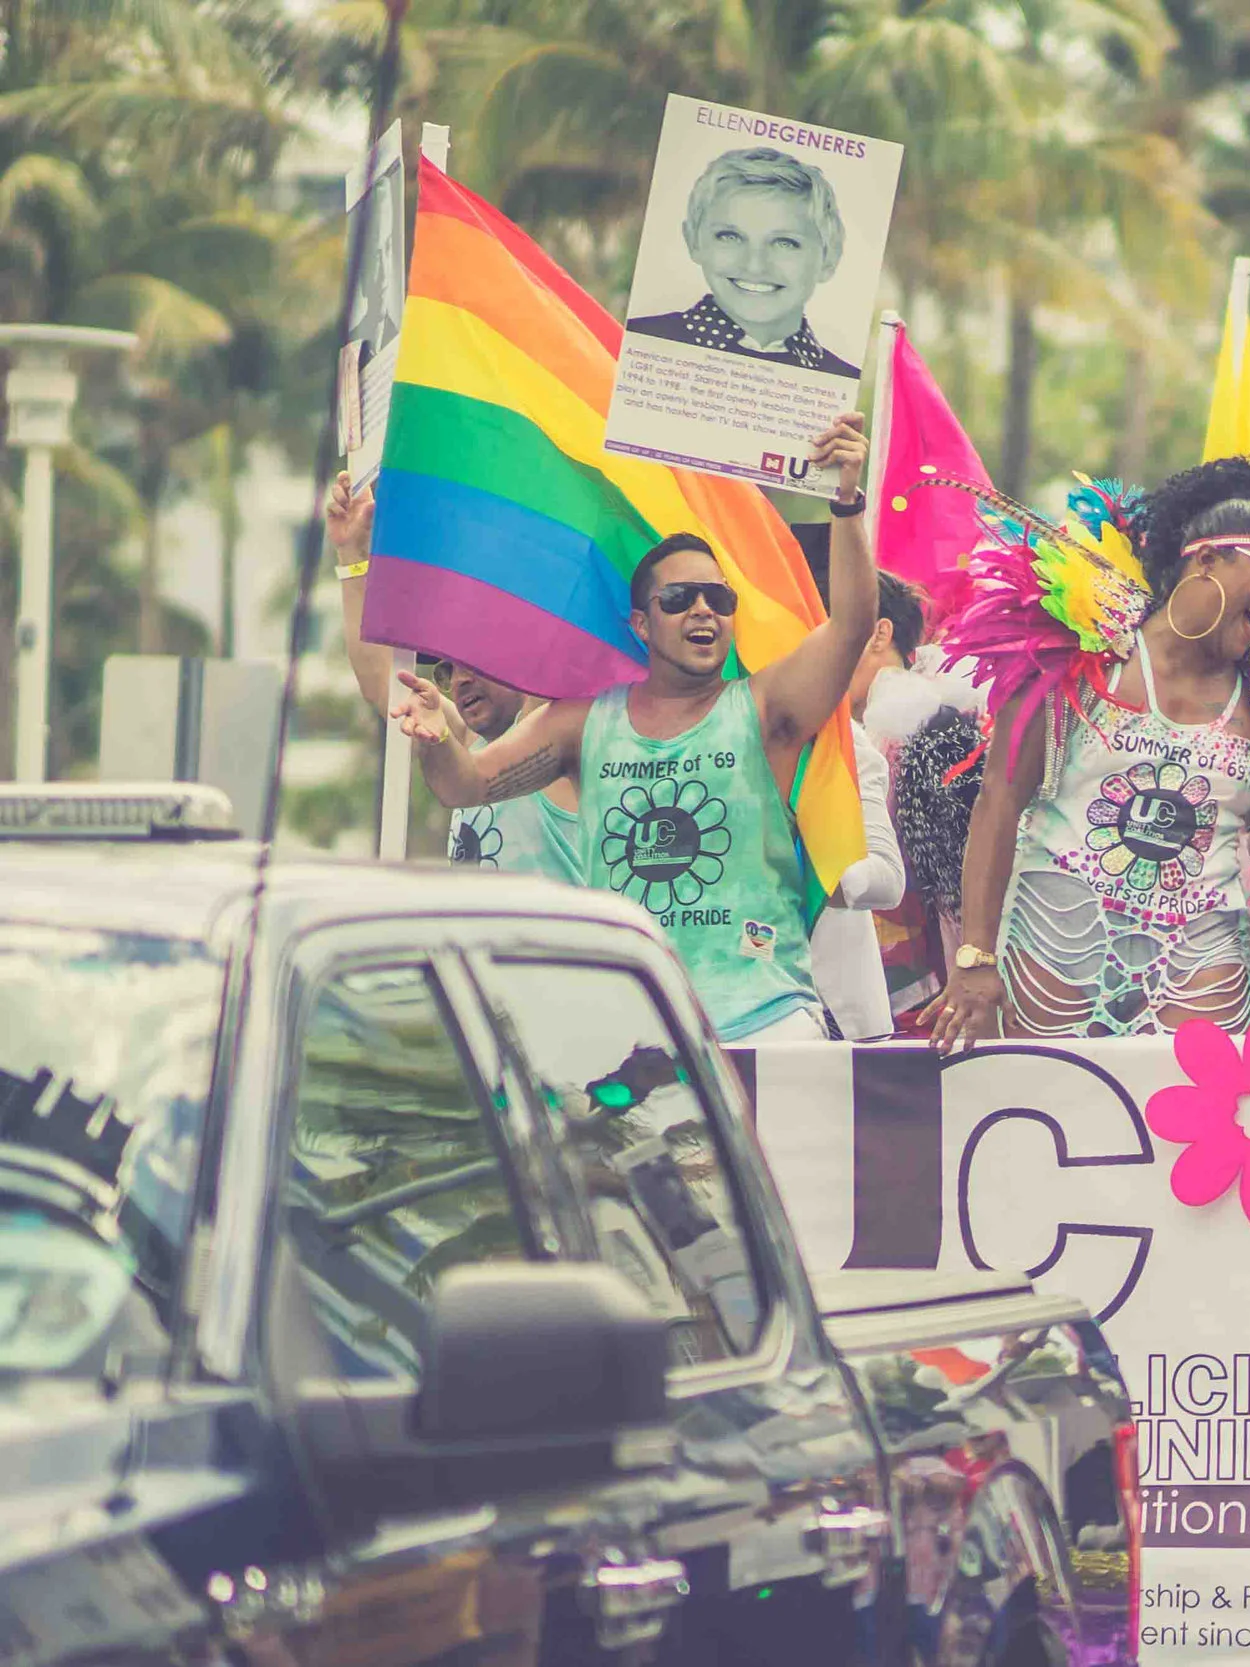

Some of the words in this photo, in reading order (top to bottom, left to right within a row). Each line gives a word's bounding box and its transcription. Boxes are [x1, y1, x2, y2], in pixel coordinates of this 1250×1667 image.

[625, 347, 673, 365] American
[1111, 734, 1193, 765] SUMMER
[1198, 754, 1215, 770] of
[600, 760, 679, 779] SUMMER
[683, 755, 702, 772] of
[1130, 795, 1177, 828] UC
[634, 819, 677, 848] UC
[1137, 892, 1157, 907] of
[1158, 896, 1207, 914] PRIDE
[660, 912, 676, 927] of
[681, 909, 732, 926] PRIDE
[1140, 1584, 1201, 1613] ship
[1211, 1586, 1232, 1609] &
[1141, 1622, 1188, 1645] ent
